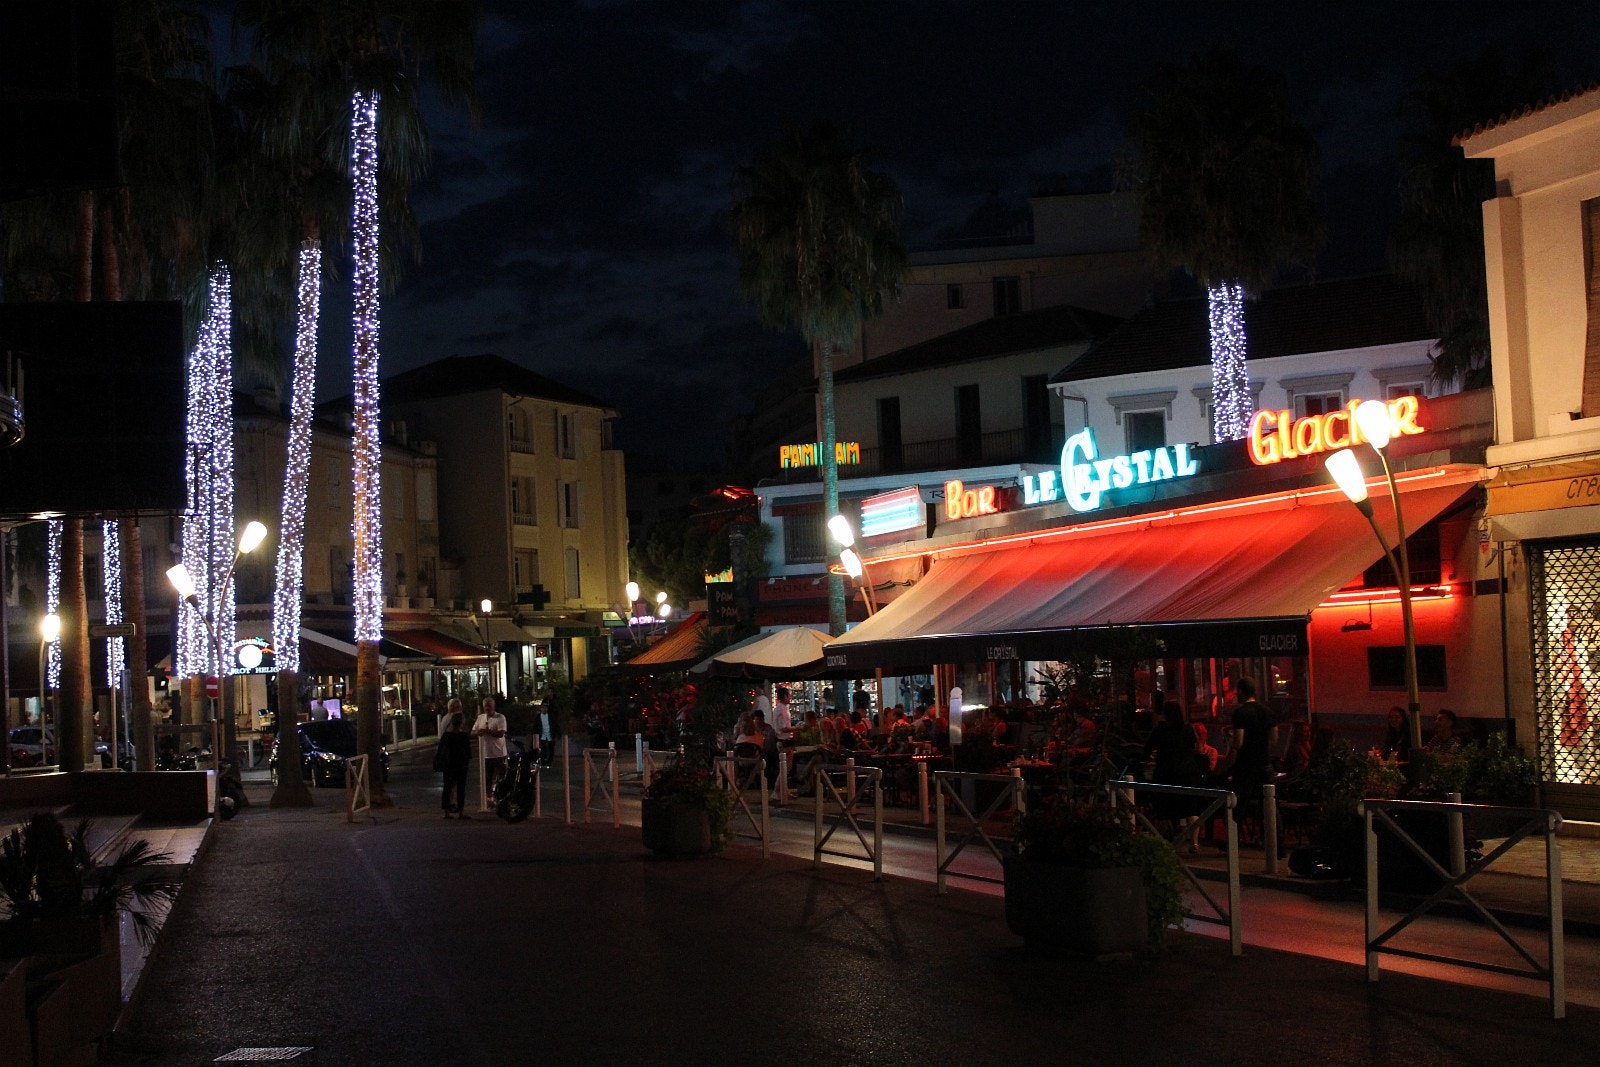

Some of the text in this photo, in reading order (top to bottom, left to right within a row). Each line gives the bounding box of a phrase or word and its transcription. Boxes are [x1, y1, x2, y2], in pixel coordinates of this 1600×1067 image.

[1023, 426, 1200, 512] LE CRYSTAL
[1259, 634, 1298, 650] GLACIER
